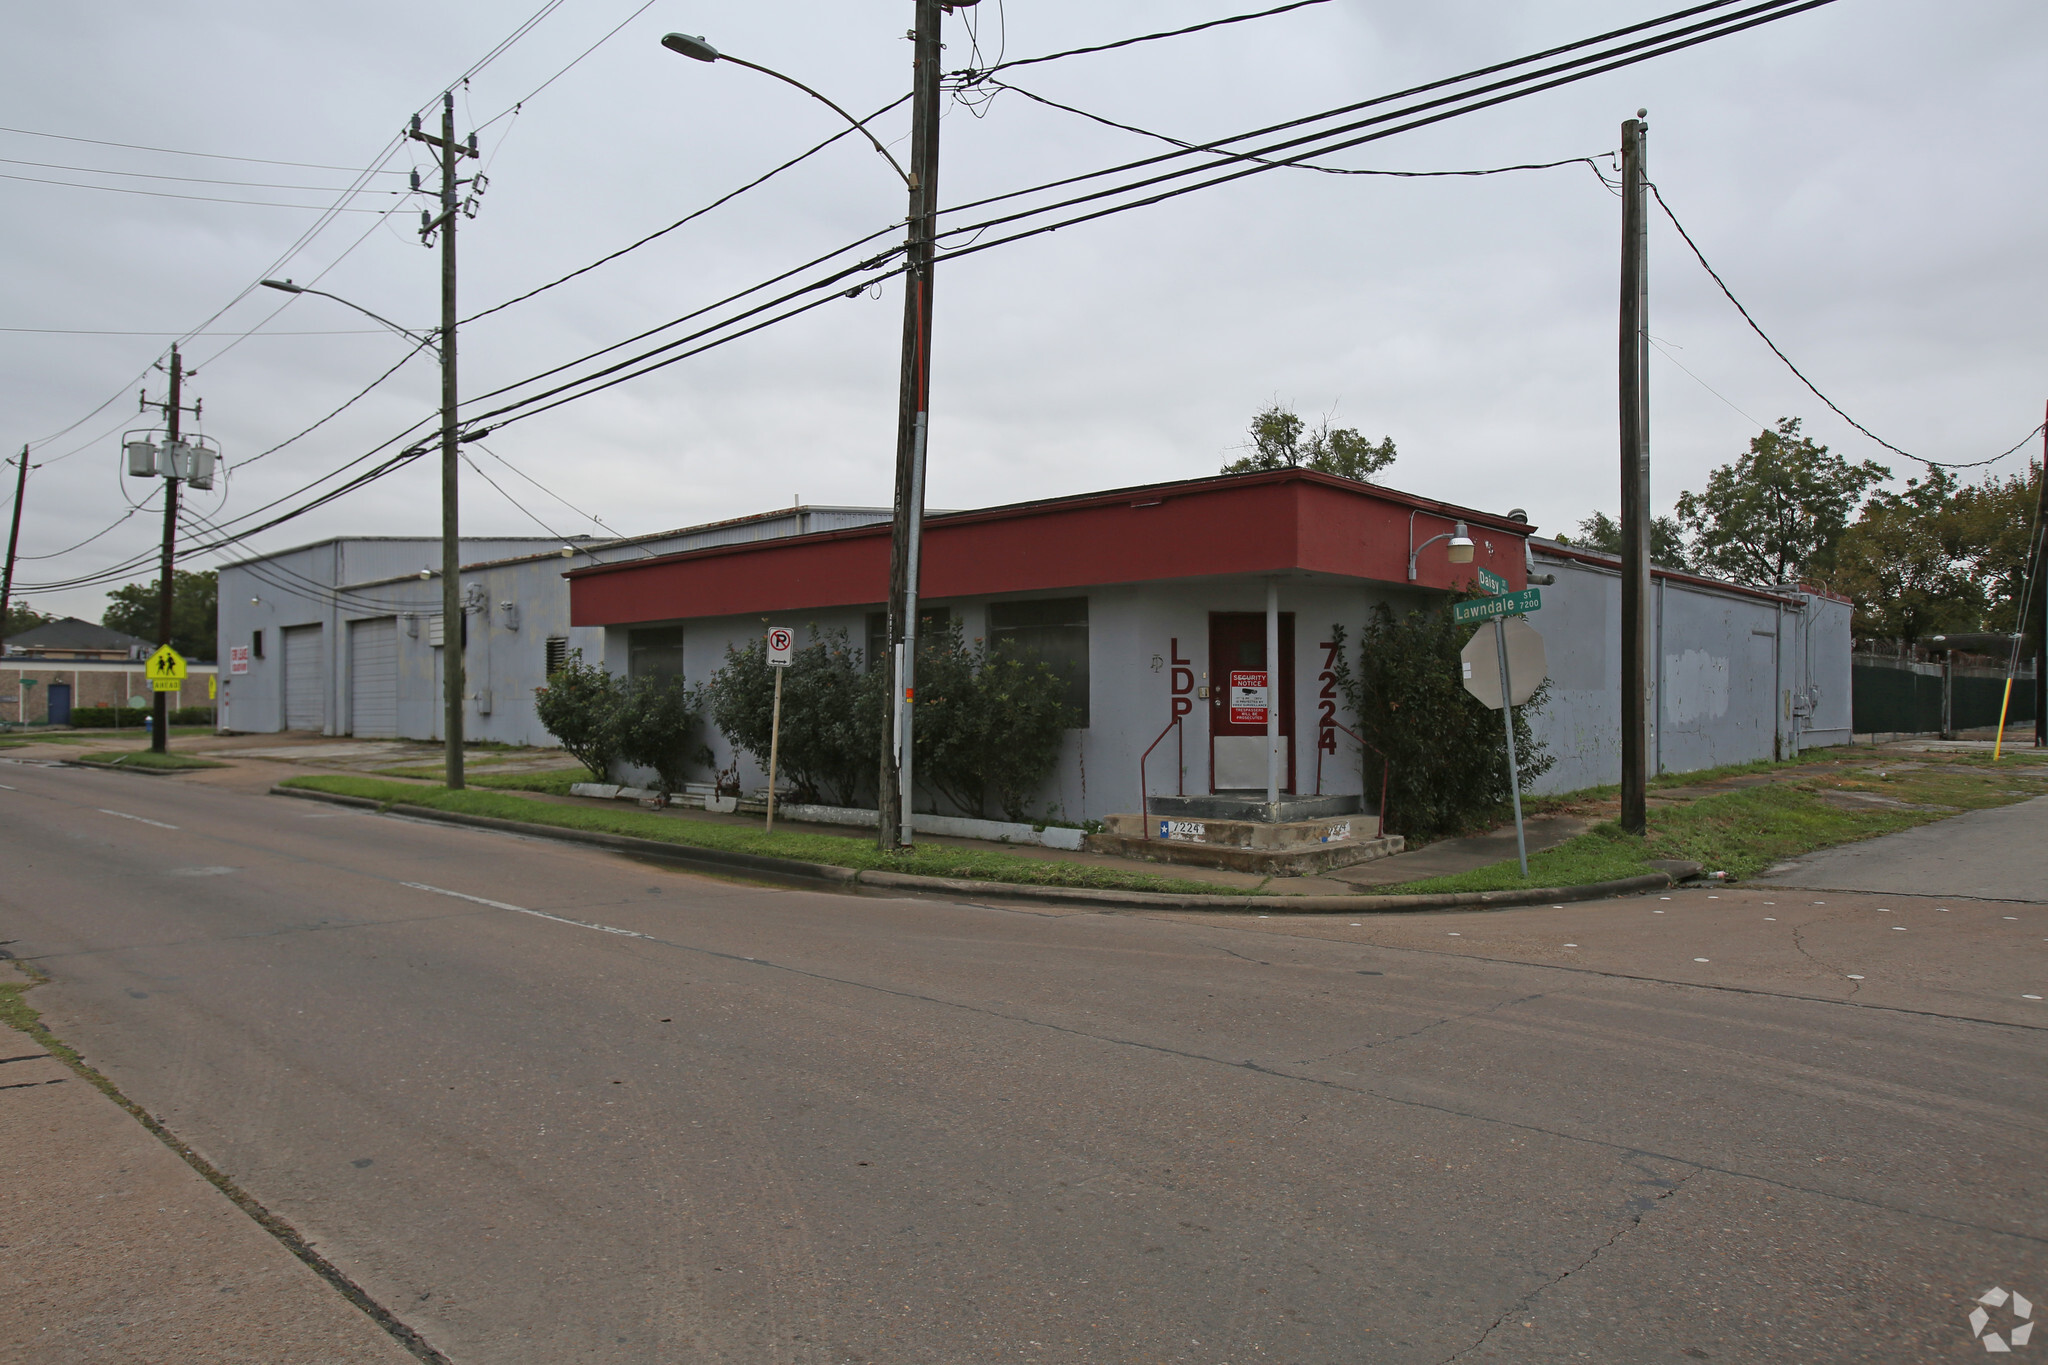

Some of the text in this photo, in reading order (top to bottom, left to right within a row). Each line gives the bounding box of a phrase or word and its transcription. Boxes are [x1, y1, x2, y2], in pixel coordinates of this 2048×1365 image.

[1479, 571, 1499, 594] Daisy
[1523, 591, 1532, 599] ST
[1456, 598, 1514, 620] Lawndale
[1520, 600, 1539, 609] 7200
[155, 681, 178, 689] AHEAD
[1171, 638, 1195, 724] LDP
[1318, 642, 1339, 755] 7224
[1173, 822, 1199, 833] 7224
